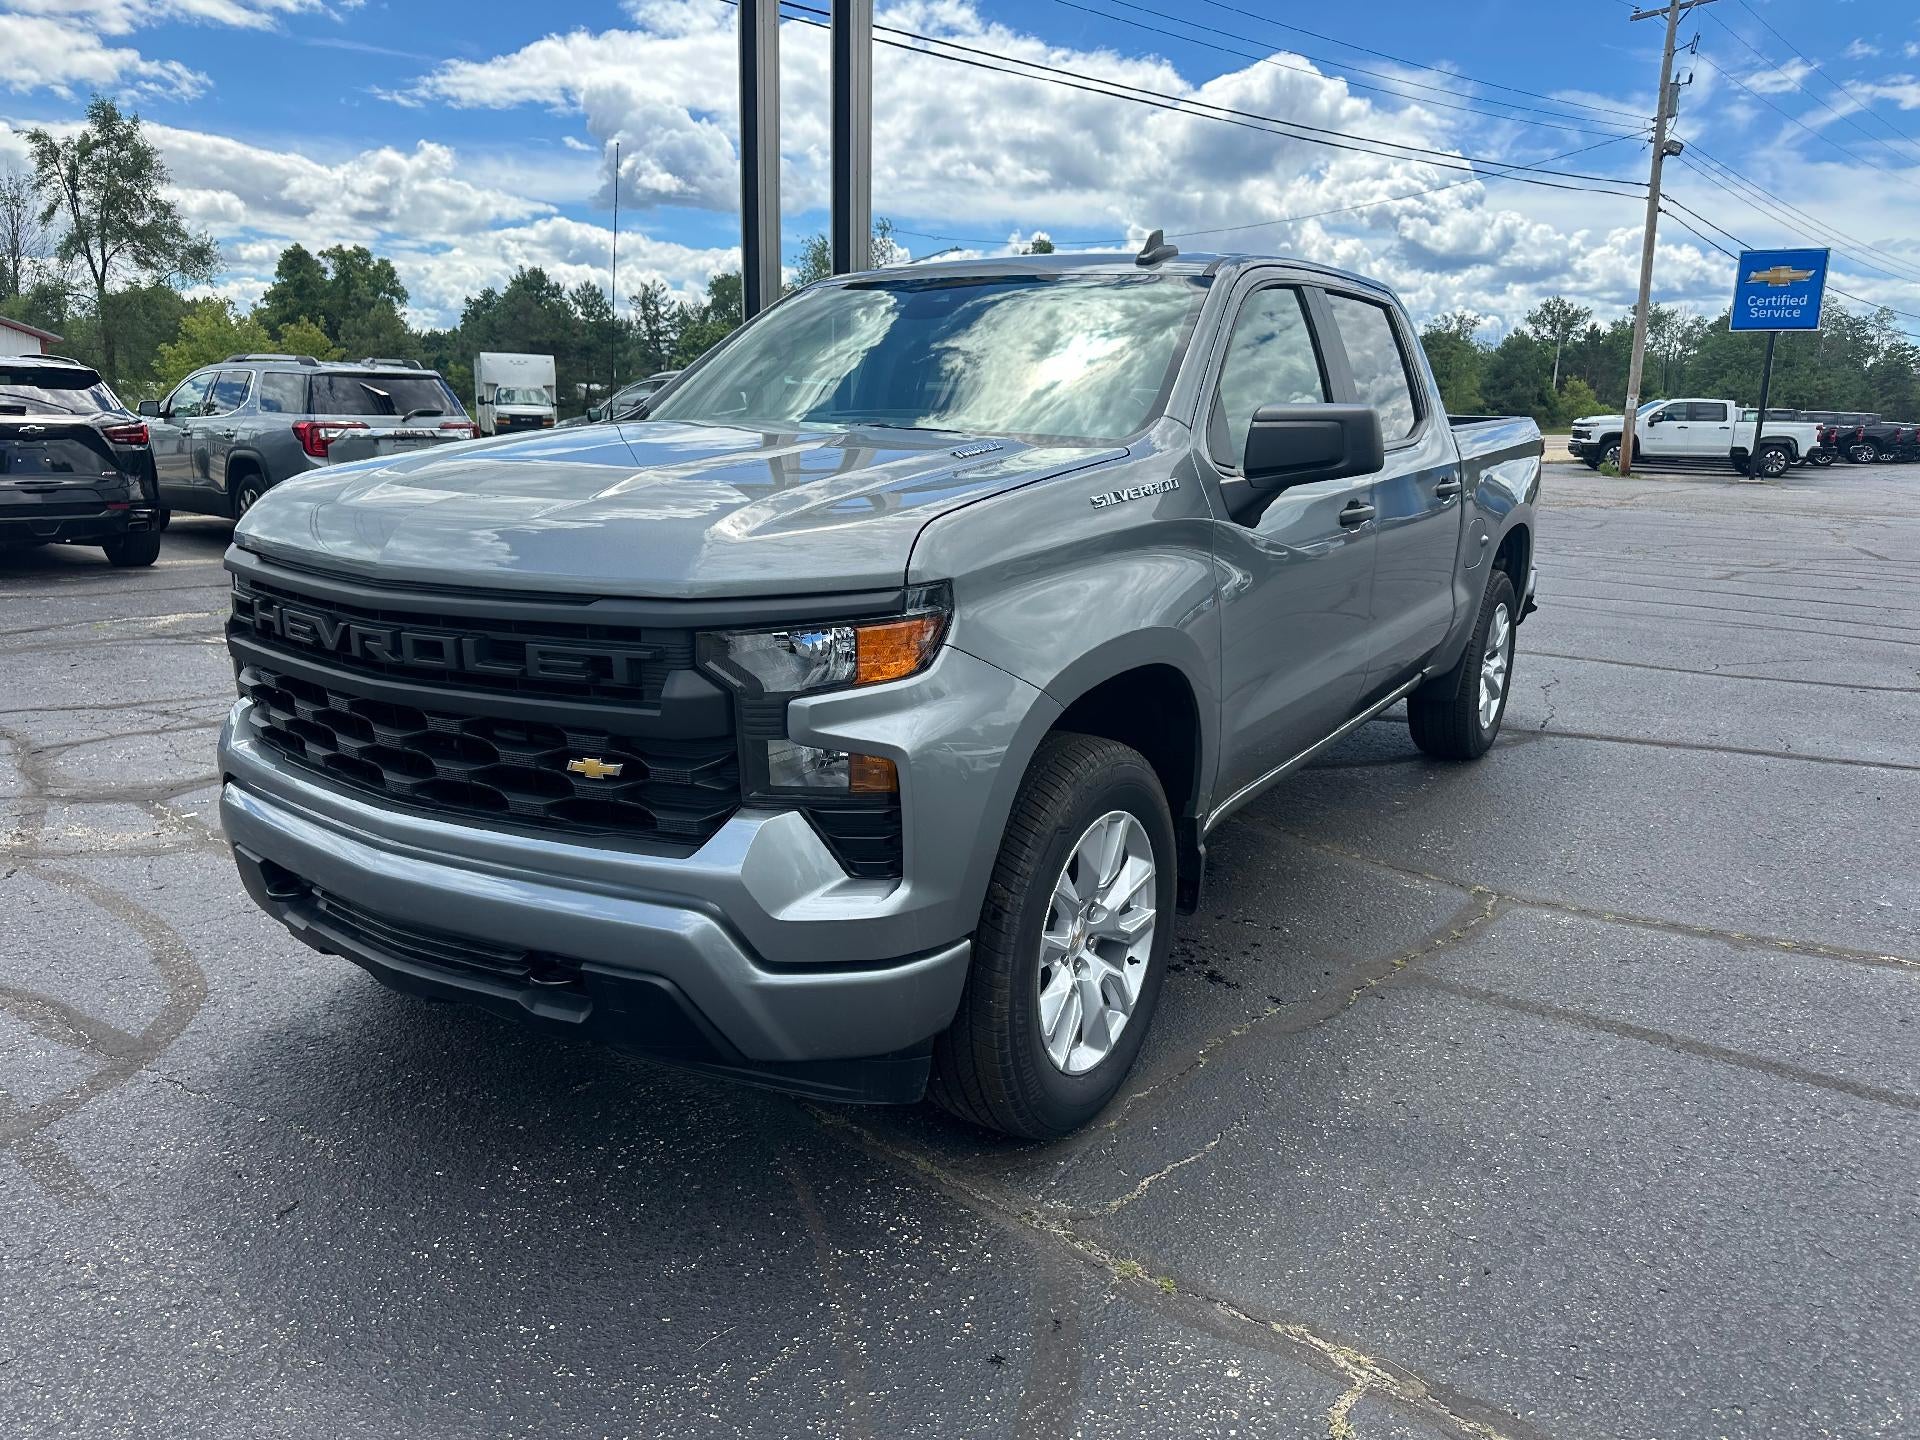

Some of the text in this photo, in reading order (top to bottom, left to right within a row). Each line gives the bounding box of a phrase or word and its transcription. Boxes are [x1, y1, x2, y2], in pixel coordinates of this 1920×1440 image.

[1747, 294, 1808, 307] Certified
[1749, 306, 1801, 318] Service
[1089, 477, 1181, 509] SILVERADO
[231, 590, 665, 687] CHEVROLET
